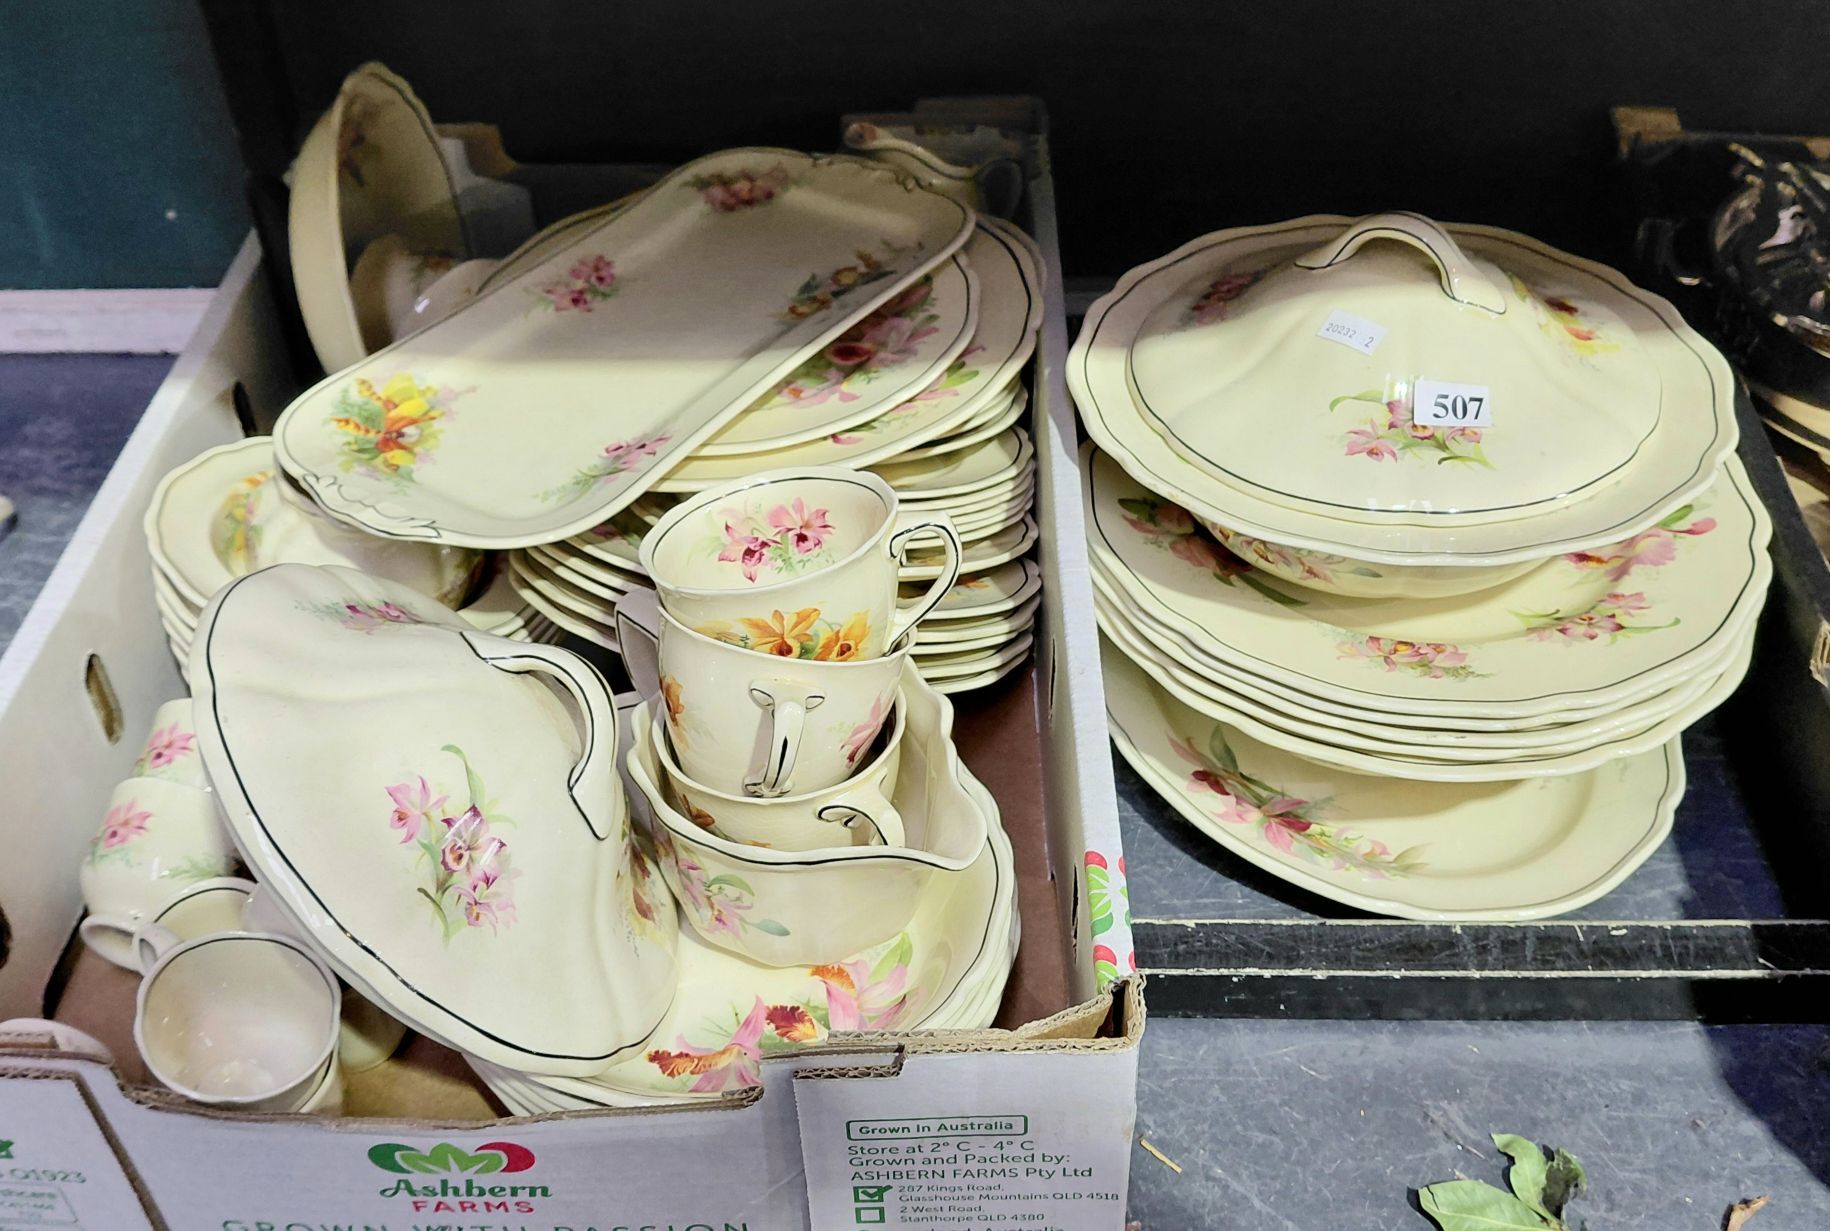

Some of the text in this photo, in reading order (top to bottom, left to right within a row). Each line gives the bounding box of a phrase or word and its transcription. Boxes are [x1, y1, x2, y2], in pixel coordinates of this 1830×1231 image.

[1364, 335, 1375, 348] 2
[1432, 393, 1485, 421] 507
[859, 1125, 911, 1135] Grown
[937, 1121, 1014, 1132] Australia
[847, 1144, 900, 1156] Store
[905, 1144, 924, 1155] at
[956, 1141, 971, 1152] C
[1020, 1140, 1035, 1151] C
[849, 1152, 1070, 1167] Grown and Packed by:
[850, 1167, 1093, 1181] ASHBERN FARMS Pty Ltd
[379, 1178, 553, 1198] Ashbern
[898, 1185, 924, 1193] 287
[927, 1185, 963, 1193] Kings
[898, 1194, 976, 1203] Glasshouse
[978, 1192, 1050, 1201] Mountains
[1086, 1192, 1120, 1200] 4518
[412, 1200, 535, 1214] FARMS
[911, 1205, 943, 1214] West
[899, 1215, 974, 1224] Stanthorpe
